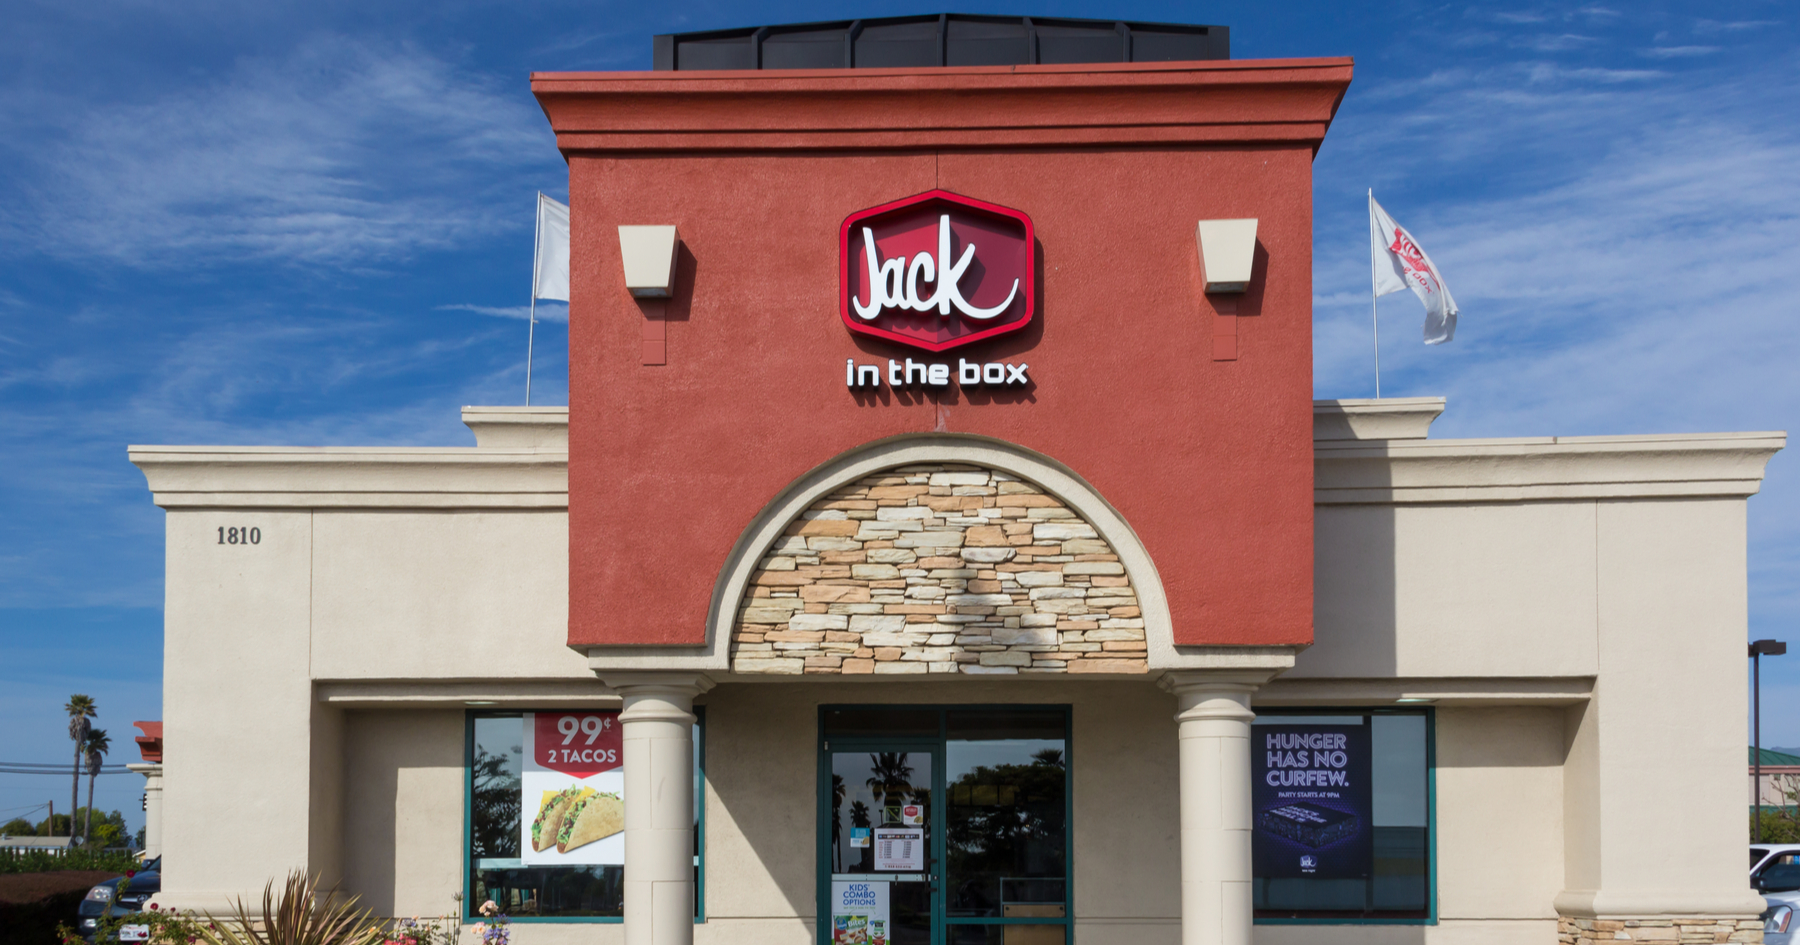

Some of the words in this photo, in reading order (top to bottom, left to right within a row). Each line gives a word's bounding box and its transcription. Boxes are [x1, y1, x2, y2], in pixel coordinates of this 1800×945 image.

[853, 214, 1019, 320] Jack
[846, 358, 880, 387] in
[888, 357, 949, 386] the
[959, 357, 1029, 385] box
[217, 526, 262, 545] 1810
[1266, 733, 1347, 750] HUNGER
[547, 749, 557, 763] 2
[561, 748, 617, 763] TACOS
[1267, 750, 1309, 768] HAS
[1314, 750, 1348, 768] NO
[1266, 770, 1350, 787] CURFEW.
[842, 890, 876, 899] COMBO
[842, 898, 876, 906] OPTIONS
